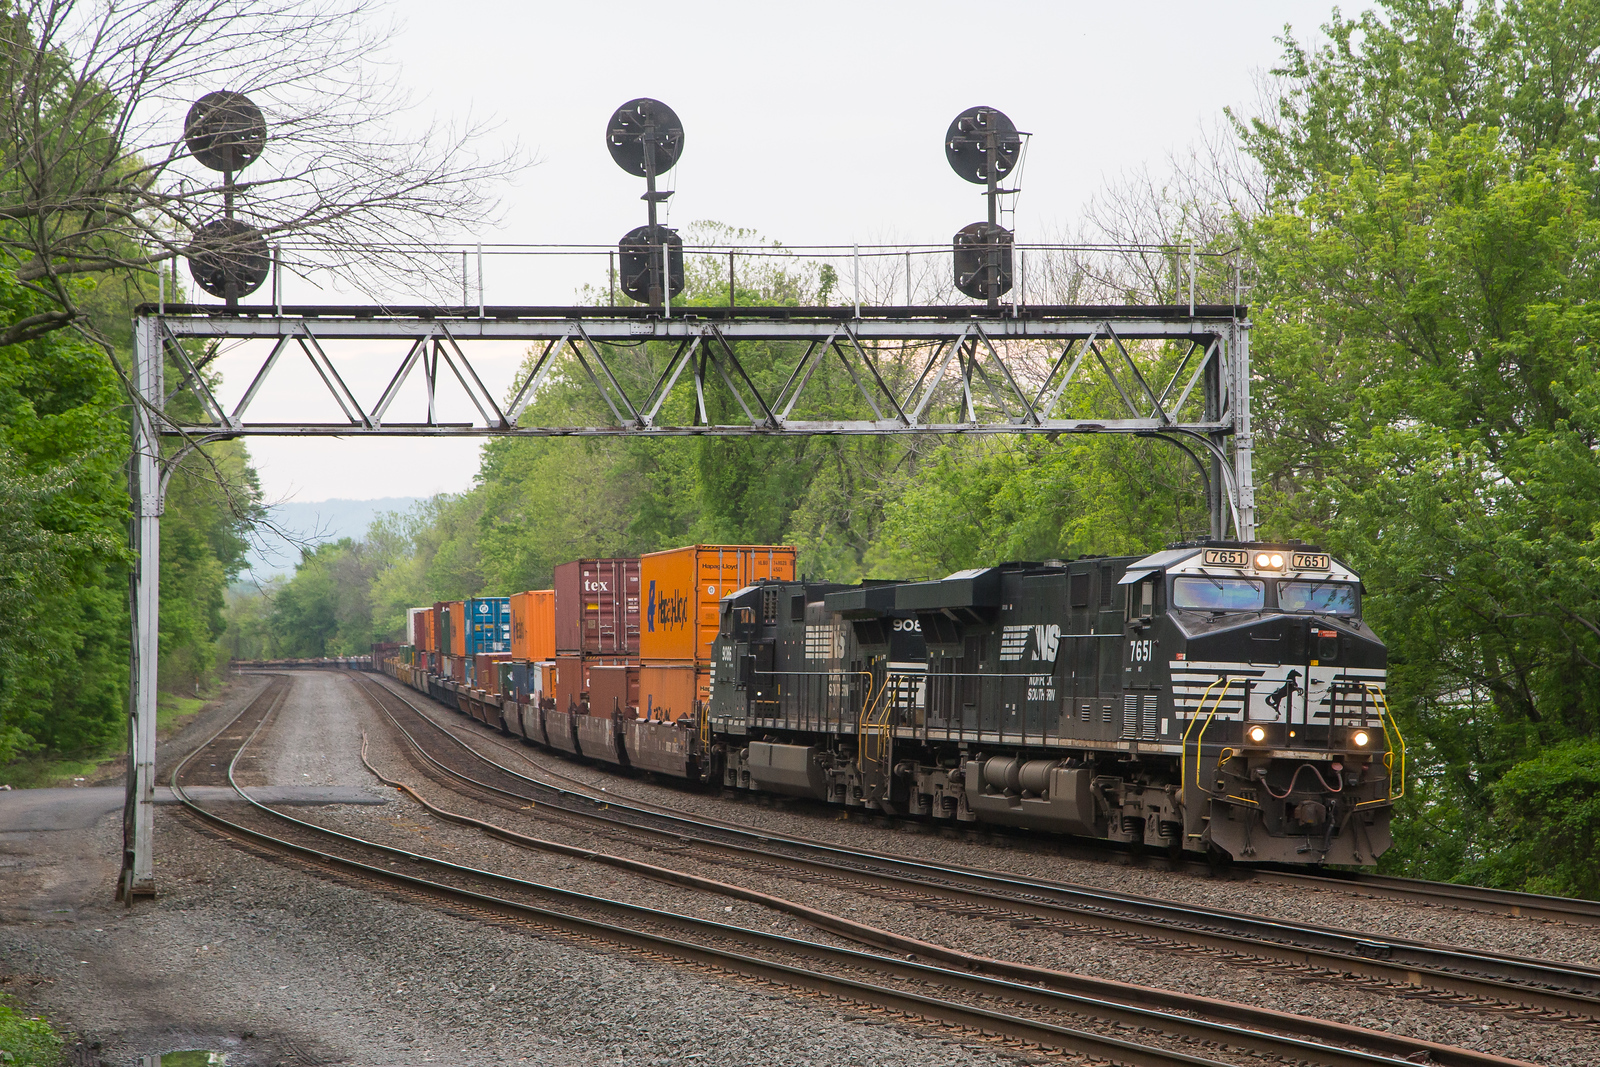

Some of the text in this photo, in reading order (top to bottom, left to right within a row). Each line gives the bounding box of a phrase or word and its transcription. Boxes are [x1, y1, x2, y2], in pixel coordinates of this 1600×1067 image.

[1210, 551, 1244, 564] 7651
[1296, 555, 1326, 567] 7651
[702, 563, 738, 571] Hapag-Lloyd
[584, 579, 609, 592] tex
[1031, 624, 1061, 663] NS
[1130, 639, 1152, 662] 7651
